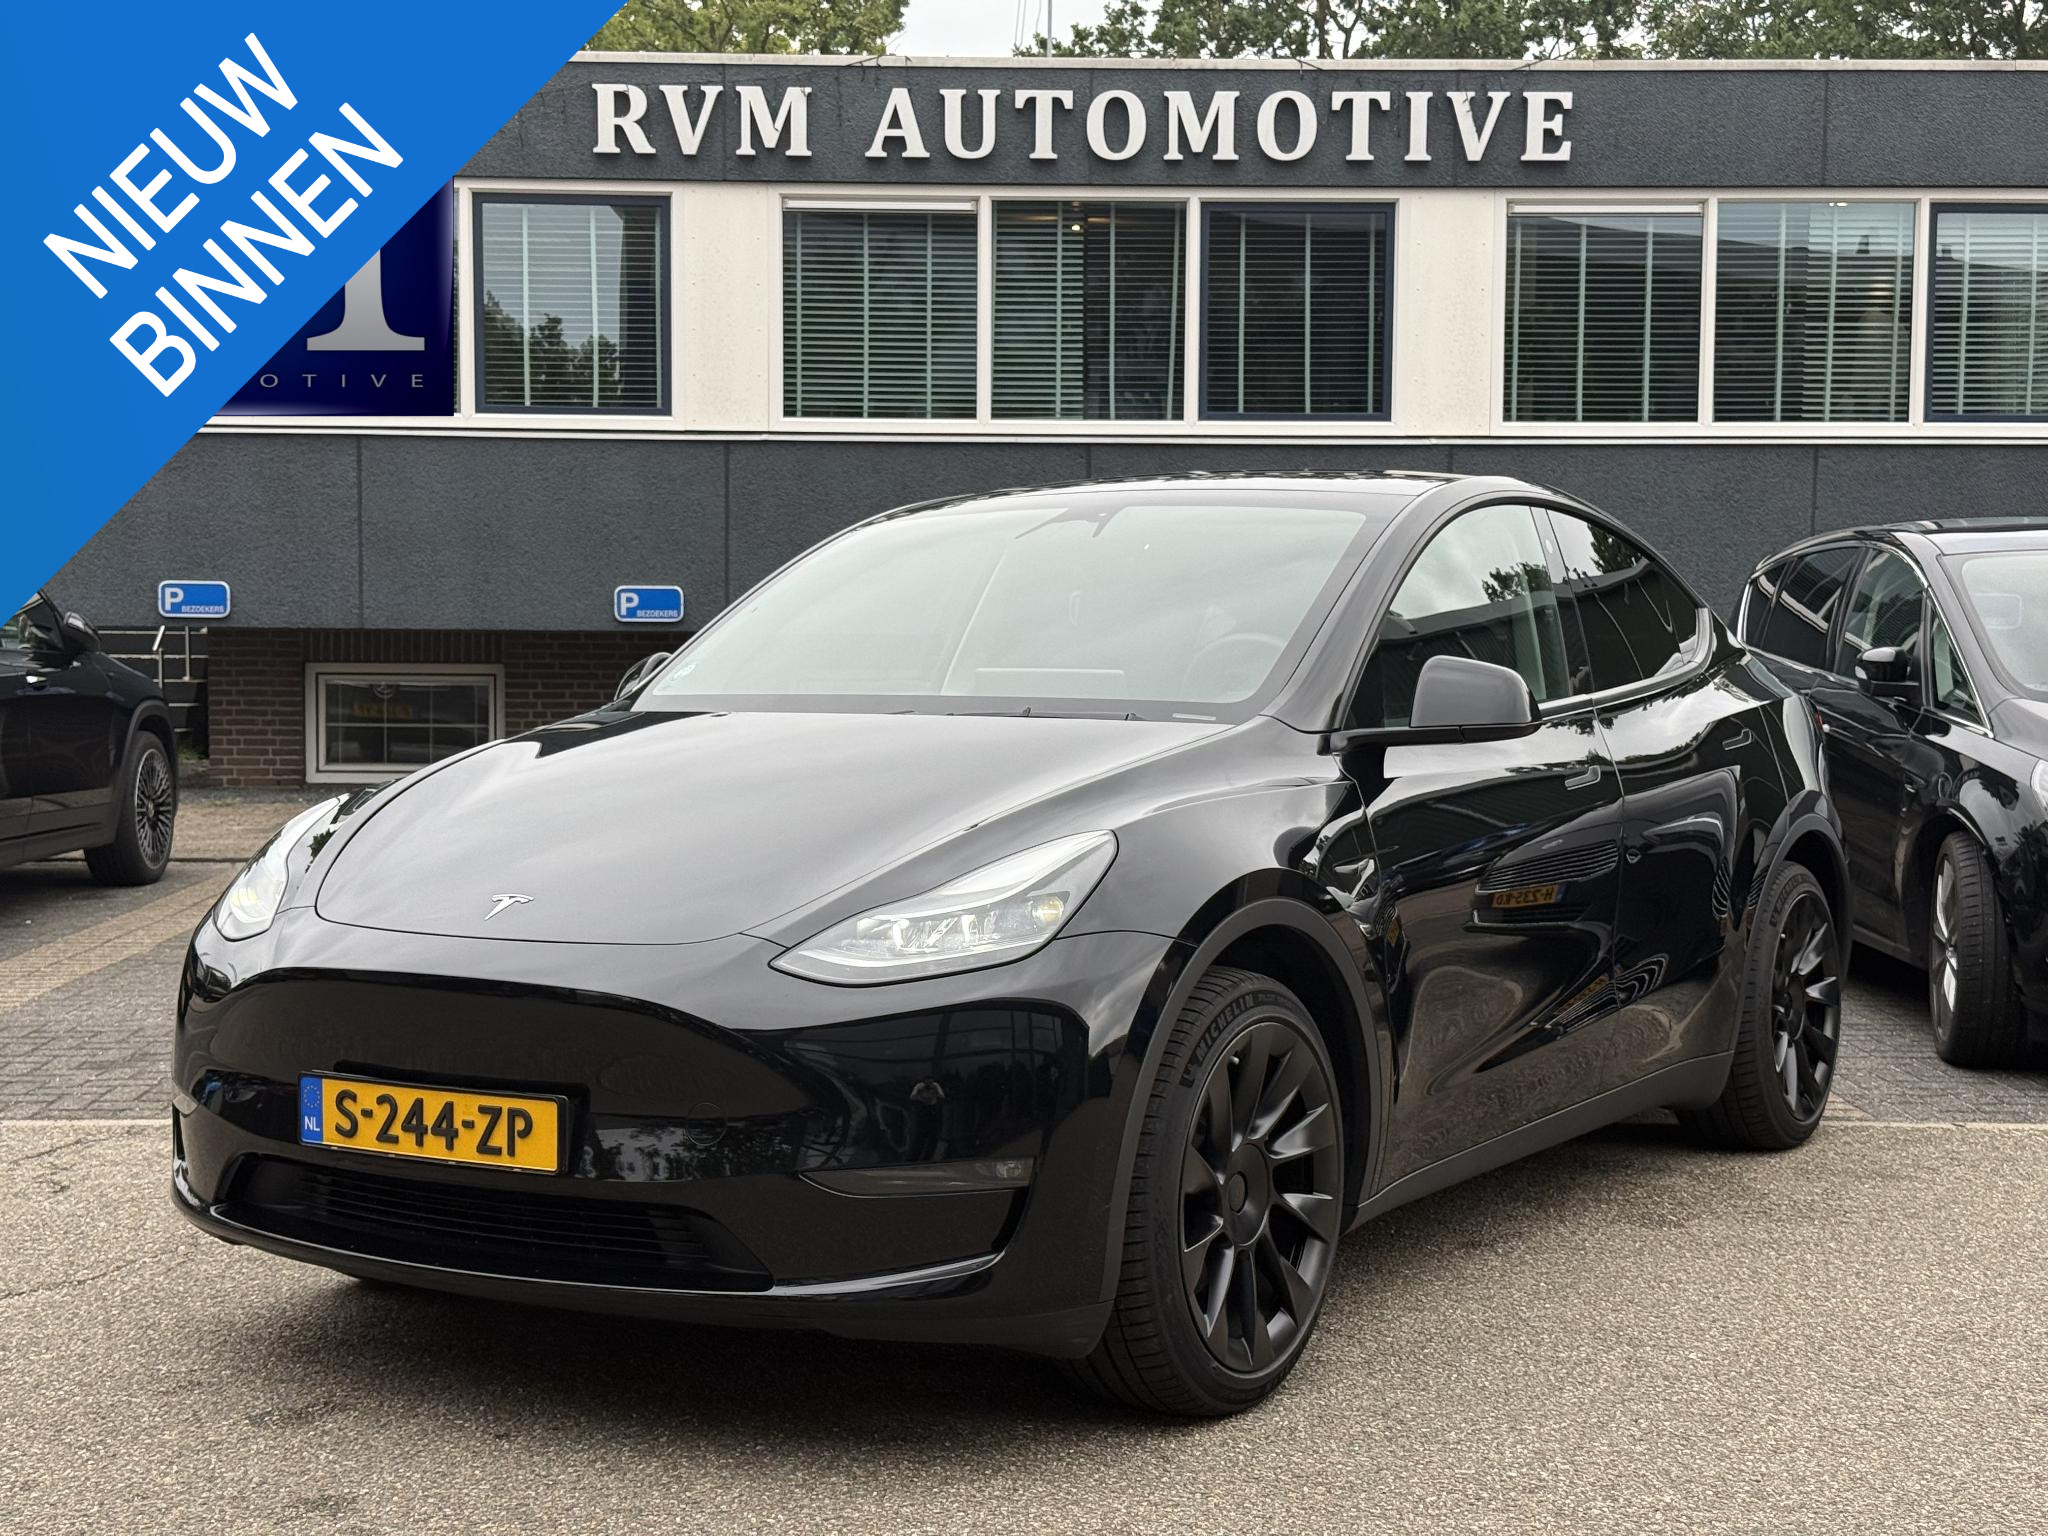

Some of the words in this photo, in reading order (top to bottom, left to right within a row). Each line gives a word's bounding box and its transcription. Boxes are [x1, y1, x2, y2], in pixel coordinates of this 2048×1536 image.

[592, 83, 813, 157] RVM
[865, 87, 1574, 162] AUTOMOTIVE
[164, 587, 184, 611] P
[182, 605, 224, 613] BEZOEKERS
[620, 592, 639, 616] P
[636, 609, 678, 617] BEZOEKERS
[1194, 993, 1255, 1064] MICHELIN
[304, 1115, 320, 1132] NL
[335, 1088, 533, 1157] S-244-ZP
